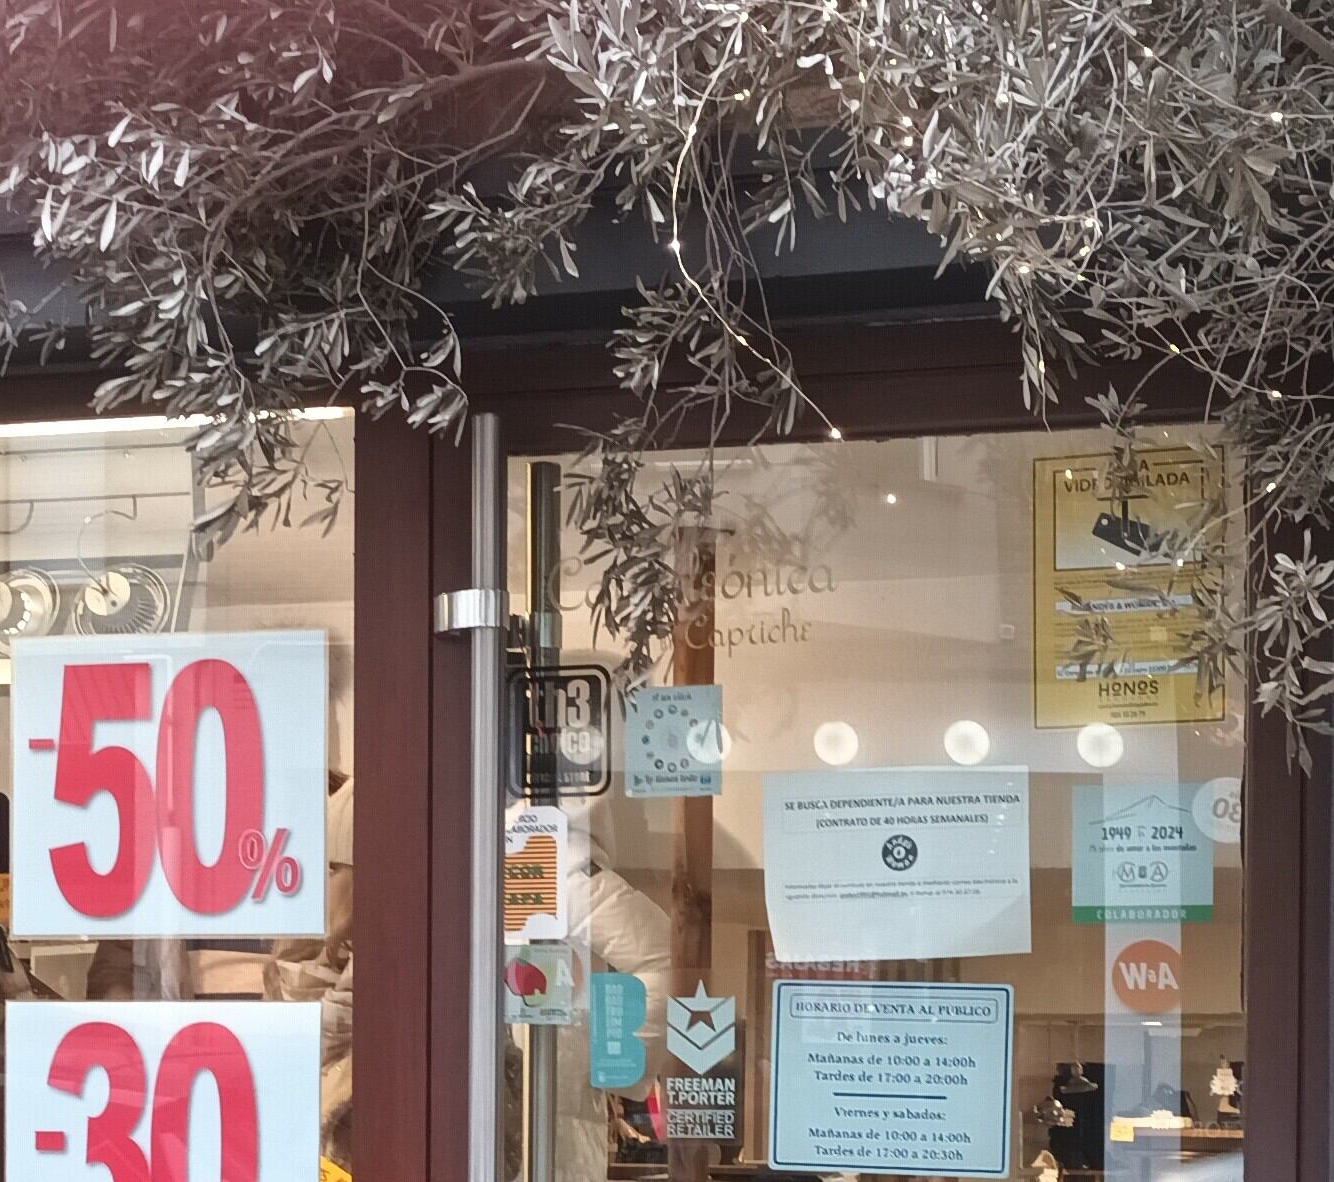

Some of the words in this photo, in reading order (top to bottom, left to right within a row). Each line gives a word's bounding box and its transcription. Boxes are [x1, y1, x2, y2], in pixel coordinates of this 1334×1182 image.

[785, 801, 796, 811] SE
[798, 799, 829, 810] BUSCA
[830, 797, 906, 809] DEPENDIENTE/A
[908, 796, 935, 808] PARA
[936, 794, 982, 806] NUESTRA
[984, 793, 1021, 804] TIENDA
[816, 817, 868, 829] (CONTRATO
[870, 816, 883, 826] DE
[884, 816, 895, 826] 40
[896, 814, 928, 825] HORAS
[930, 812, 989, 825] SEMANALES)
[1102, 827, 1131, 841] 1949
[1151, 826, 1183, 840] 2024
[1096, 909, 1188, 920] COLABORADOR
[795, 1002, 851, 1014] HORARIO
[854, 1003, 869, 1014] DE
[874, 1004, 915, 1015] VENTA
[920, 1006, 936, 1016] AL
[837, 1031, 853, 1042] De
[856, 1031, 890, 1043] lunes
[894, 1036, 901, 1044] a
[903, 1033, 948, 1047] jueves:
[807, 1052, 864, 1065] Mañanas
[867, 1053, 883, 1065] de
[887, 1055, 921, 1067] 10:00
[924, 1058, 931, 1066] a
[935, 1056, 977, 1069] 14:00h
[666, 1077, 736, 1091] FREEMAN
[814, 1070, 855, 1082] Tardes
[858, 1071, 873, 1083] de
[877, 1072, 911, 1084] 17:00
[914, 1076, 921, 1084] a
[925, 1074, 968, 1086] 20:00h
[666, 1091, 736, 1106] T.PORTER
[666, 1110, 736, 1124] CERTIFIED
[834, 1106, 880, 1120] Viernes
[882, 1111, 889, 1121] y
[666, 1124, 736, 1137] RETAILER
[808, 1127, 863, 1139] Mañanas
[865, 1128, 881, 1140] de
[884, 1130, 917, 1142] 10:00
[920, 1134, 927, 1142] a
[932, 1132, 972, 1144] 14:00h
[813, 1145, 854, 1157] Tardes
[857, 1146, 872, 1158] de
[876, 1147, 909, 1159] 17:00
[912, 1151, 919, 1159] a
[921, 1149, 964, 1161] 20:30h
